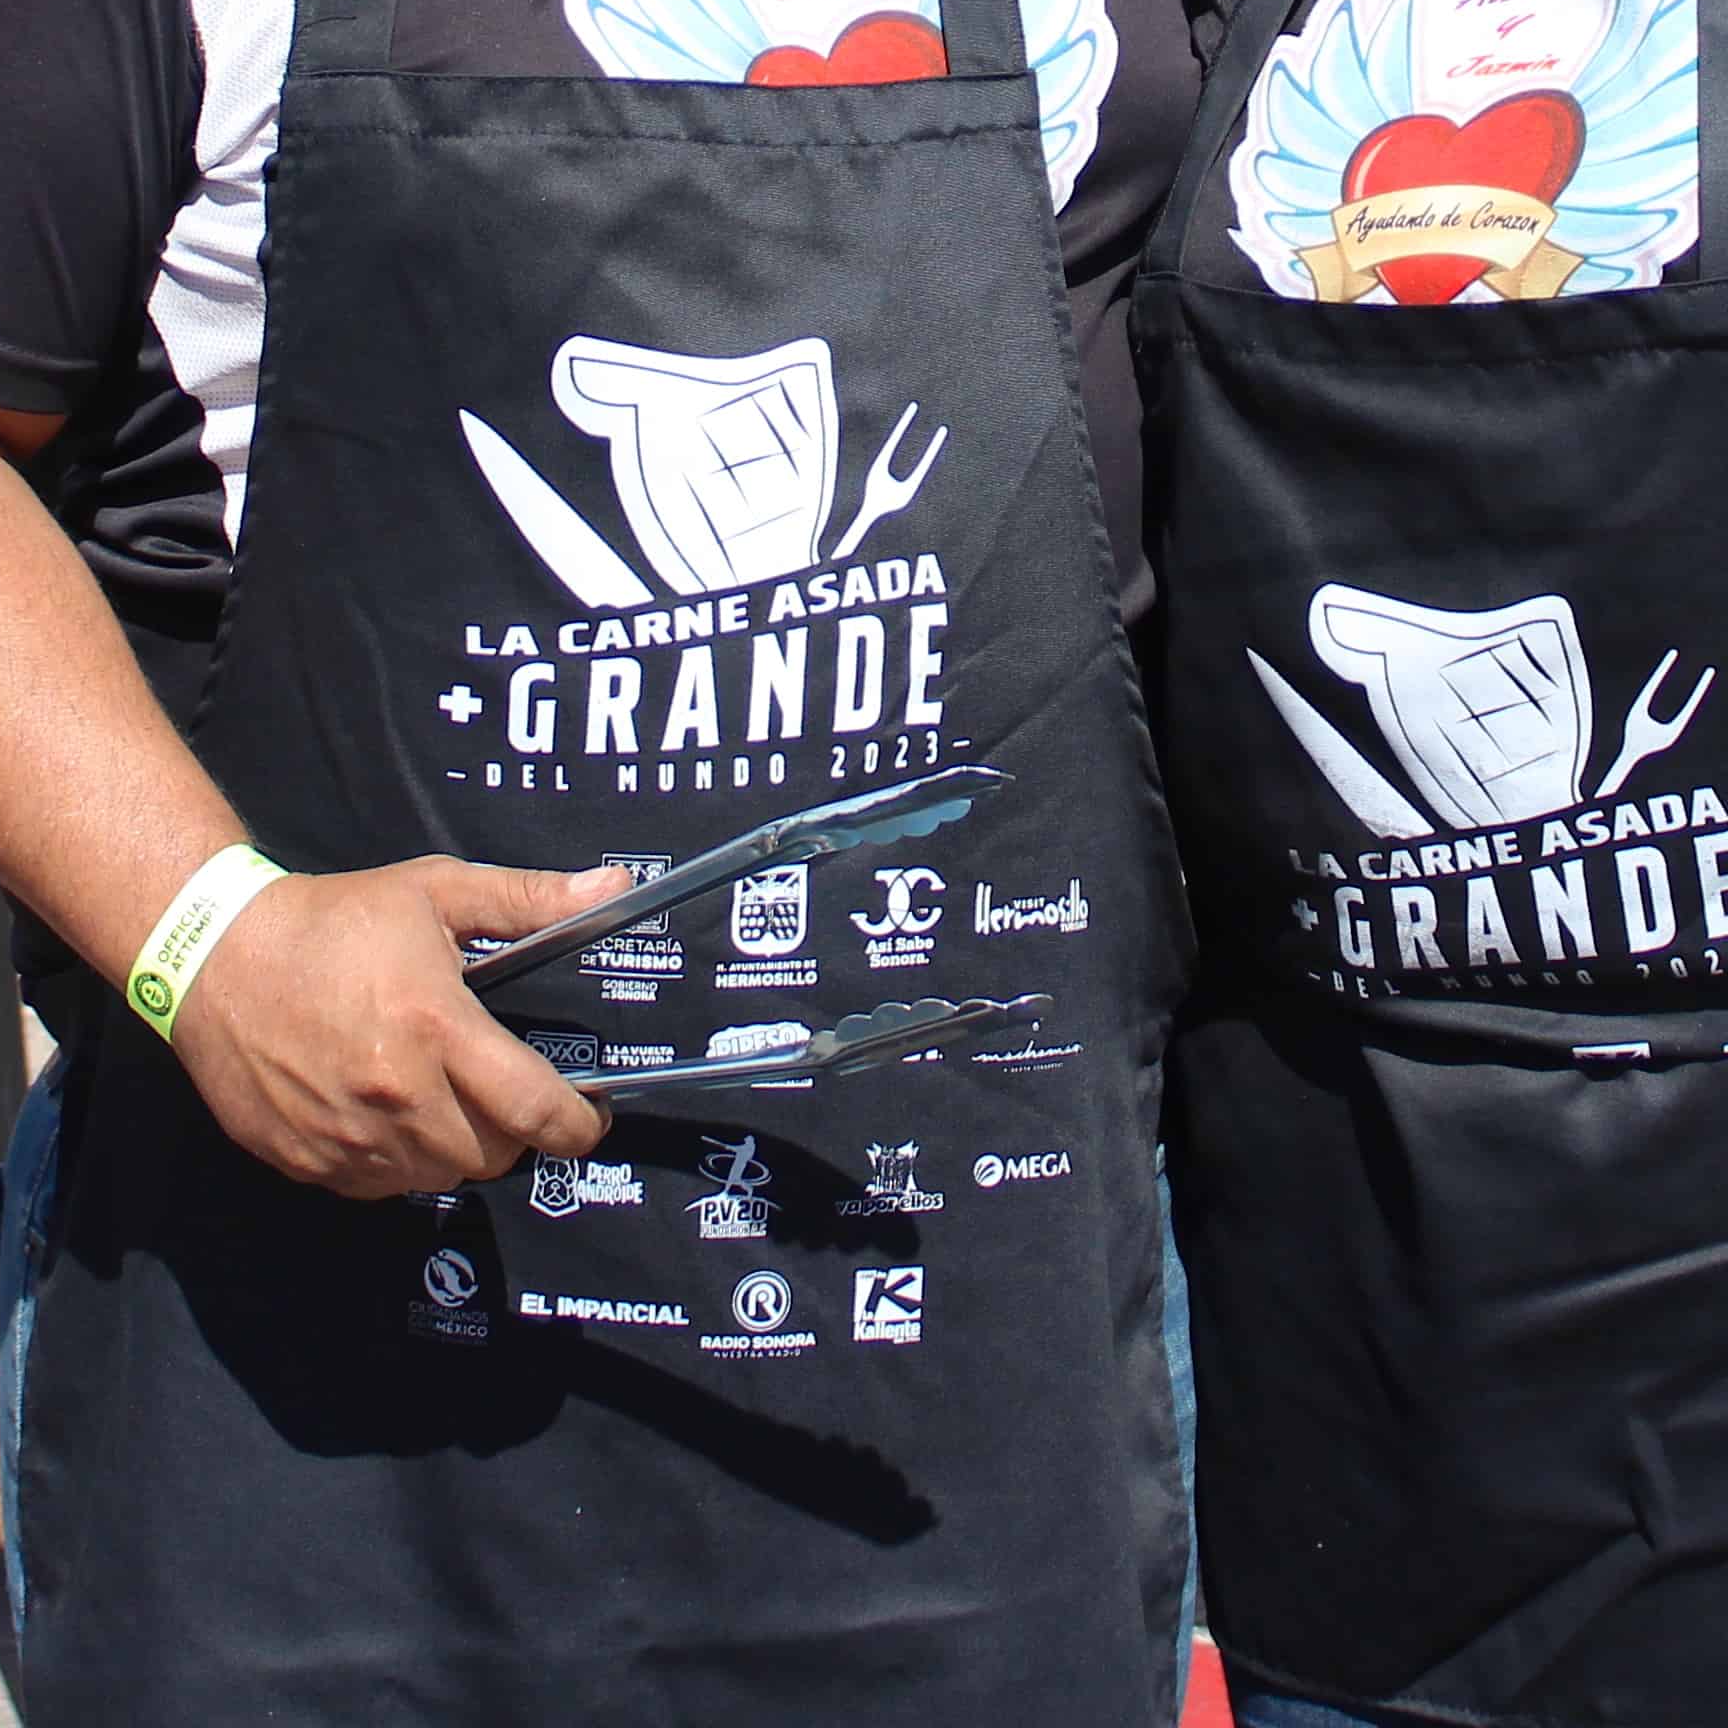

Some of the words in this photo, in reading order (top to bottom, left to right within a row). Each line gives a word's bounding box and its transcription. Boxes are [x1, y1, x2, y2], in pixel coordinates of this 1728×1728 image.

[1345, 203, 1436, 243] Ayudando
[1440, 202, 1462, 228] de
[465, 624, 540, 656] LA
[558, 593, 750, 653] CARNE
[768, 553, 947, 623] ASADA
[618, 752, 786, 792] MUNDO
[1288, 848, 1348, 881] LA
[1357, 831, 1523, 881] CARNE
[975, 878, 1089, 935] Hermosillo
[1013, 897, 1046, 910] VISIT
[158, 895, 211, 963] OFFICIAL
[581, 953, 597, 966] DE
[597, 952, 683, 970] TURISMO
[602, 979, 659, 992] GOBIERNO
[715, 970, 818, 988] HERMOSILLO
[611, 989, 658, 1002] SONORA
[621, 1055, 640, 1066] TU
[630, 1045, 675, 1056] VUELTA
[587, 1162, 632, 1186] PERRO
[1004, 1151, 1071, 1181] MEGA
[577, 1180, 643, 1204] ANDROIDE
[520, 1292, 552, 1315] EL
[557, 1296, 690, 1326] IMPARCIAL
[700, 1334, 750, 1349] RADIO
[752, 1332, 816, 1349] SONORA
